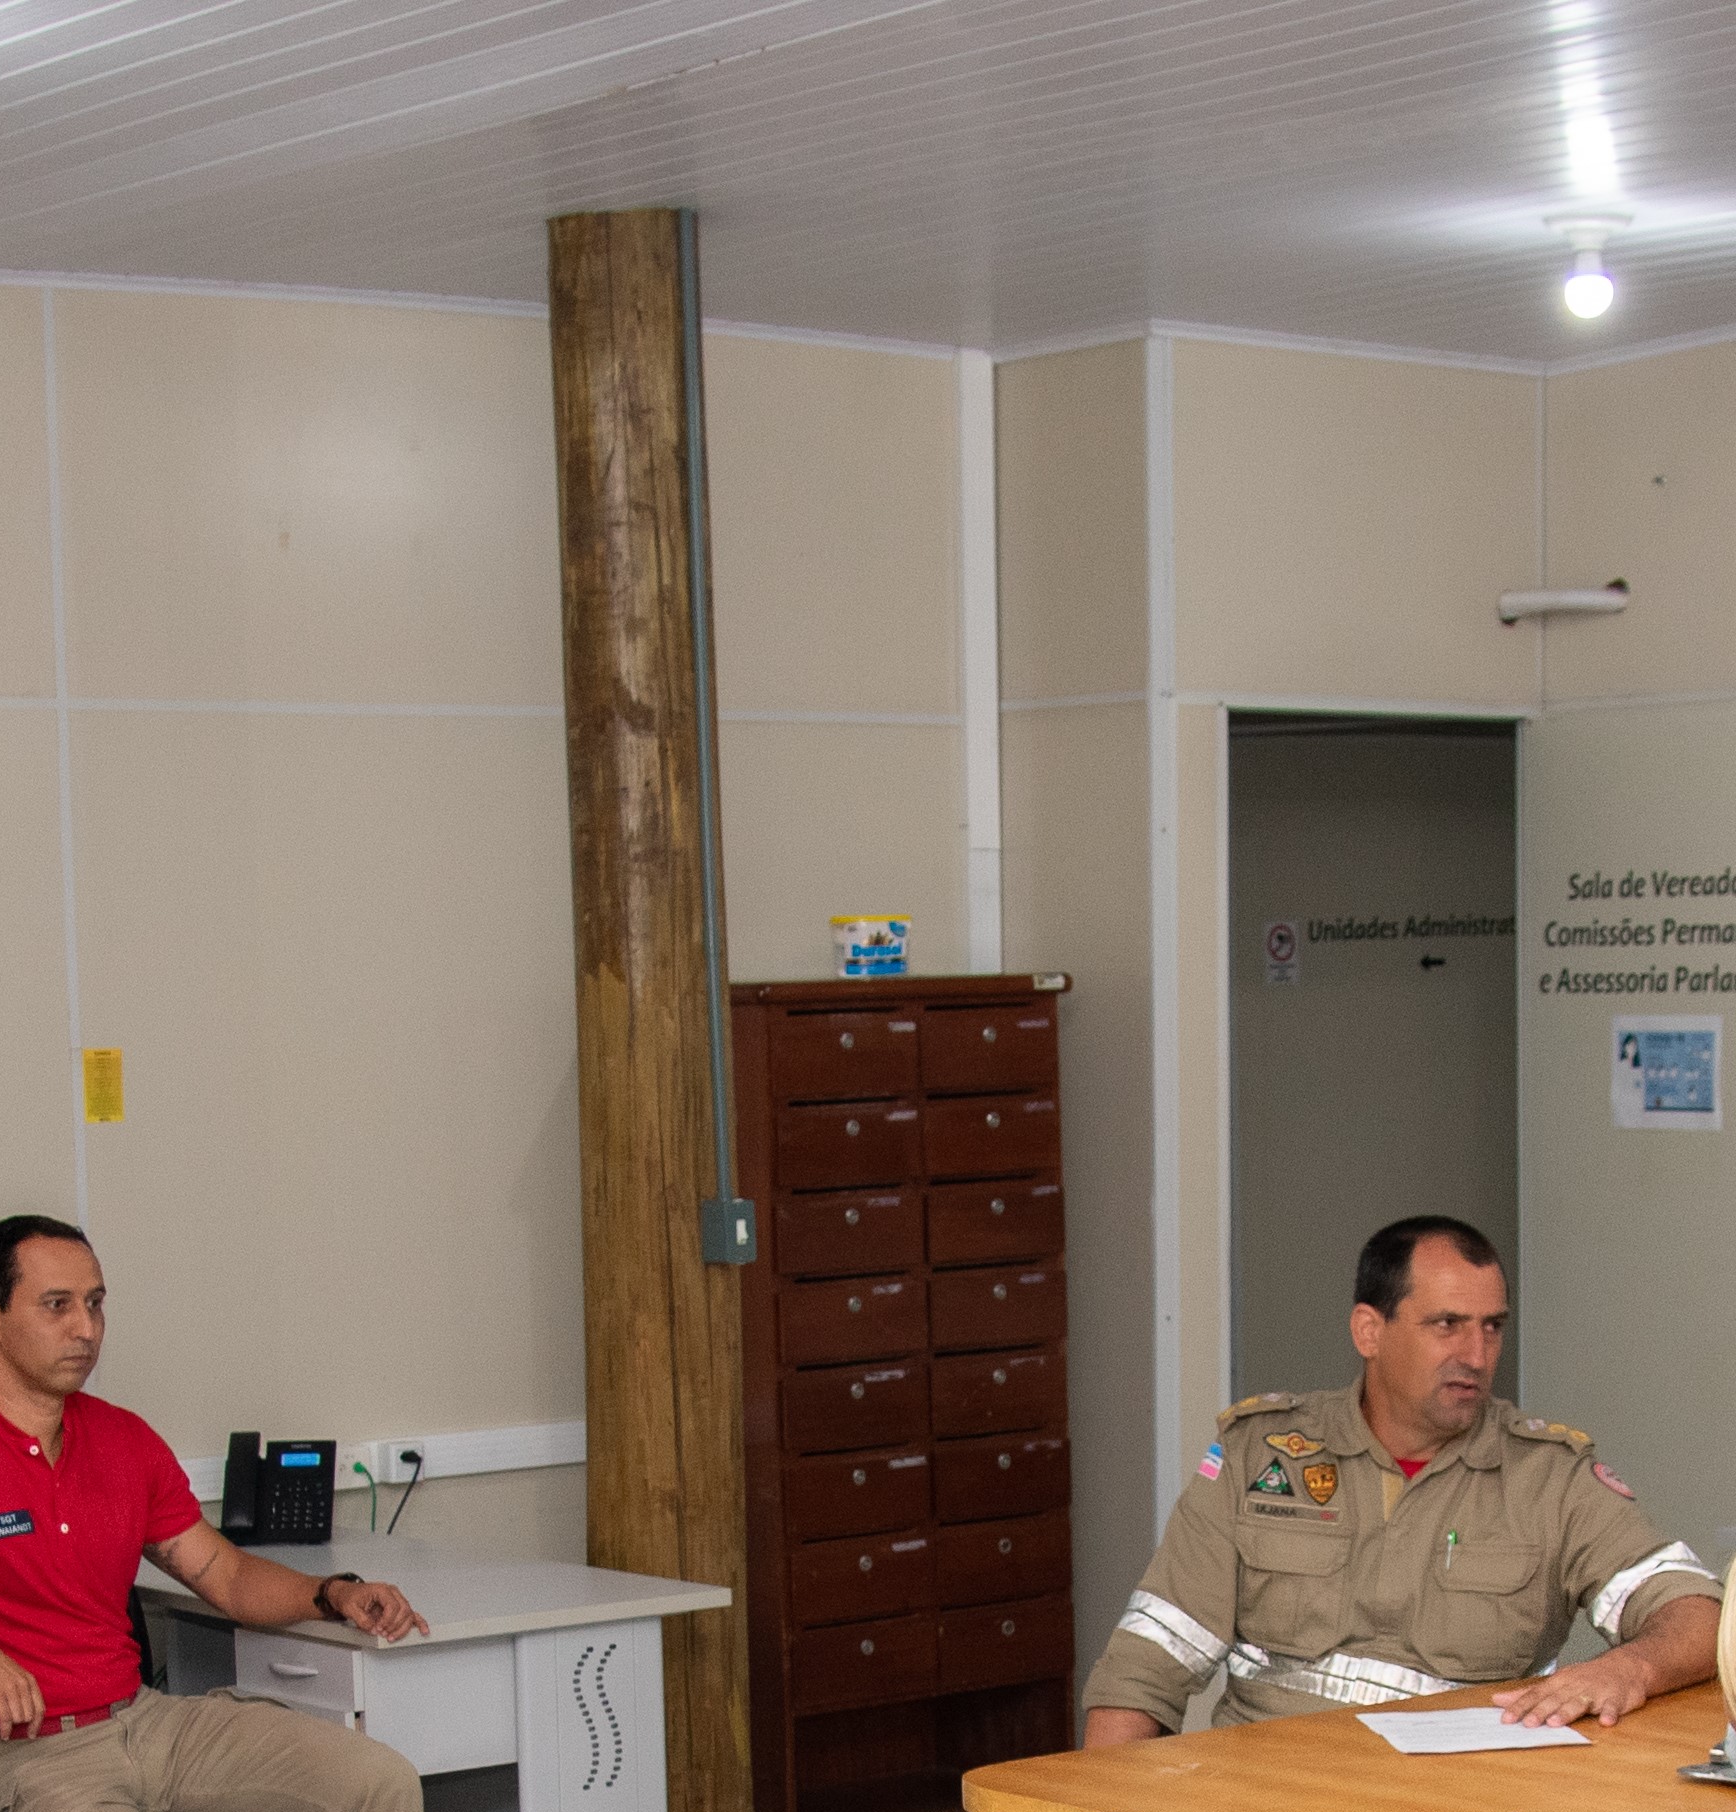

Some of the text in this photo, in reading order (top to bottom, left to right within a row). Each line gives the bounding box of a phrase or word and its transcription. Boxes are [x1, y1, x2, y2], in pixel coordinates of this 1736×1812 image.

[1568, 871, 1613, 900] Sala
[1619, 869, 1645, 899] de
[1308, 917, 1398, 943] Unidades
[1544, 918, 1655, 947] Comissões
[1539, 971, 1552, 993] e
[1556, 965, 1668, 994] Assessoria
[0, 1514, 16, 1525] SGT
